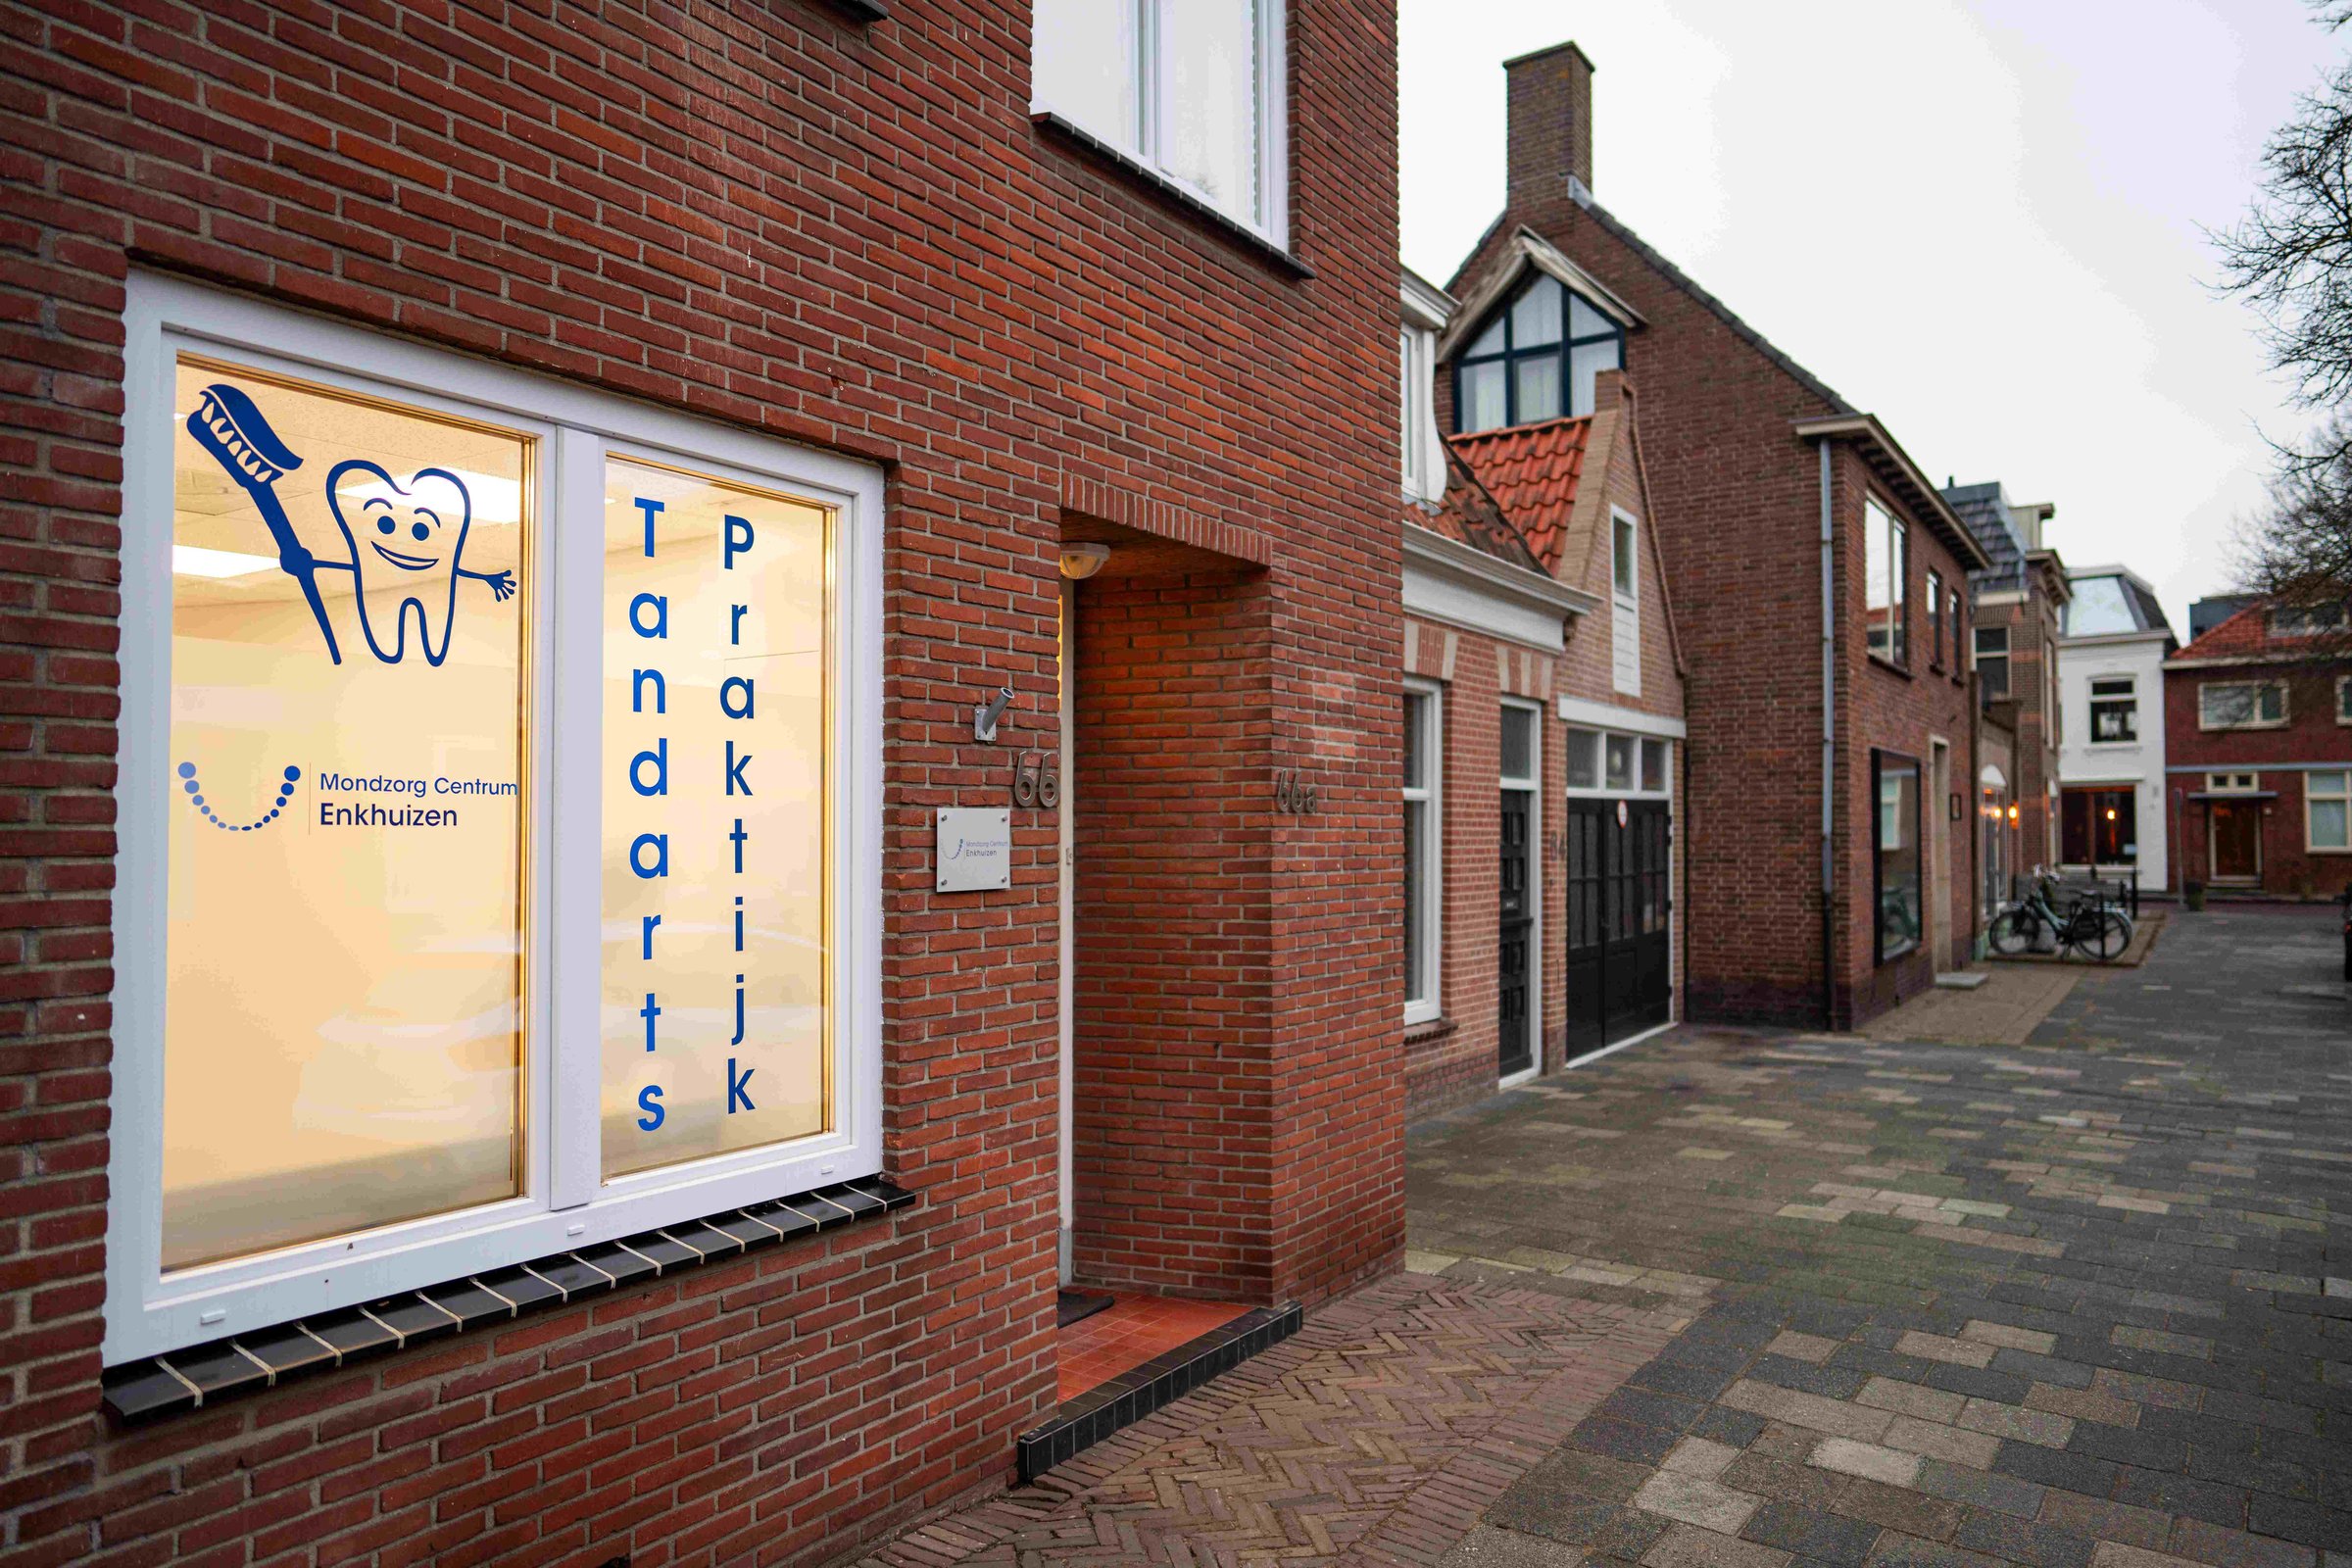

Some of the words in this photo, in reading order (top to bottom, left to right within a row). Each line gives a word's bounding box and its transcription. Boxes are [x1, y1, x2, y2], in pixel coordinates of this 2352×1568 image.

[320, 772, 426, 798] Mondzorg
[434, 777, 517, 796] Centrum
[1015, 751, 1059, 807] 66
[1277, 768, 1317, 813] 66a
[320, 802, 458, 826] Enkhuizen
[628, 497, 668, 1131] Tandarts
[719, 514, 756, 1114] Praktijk
